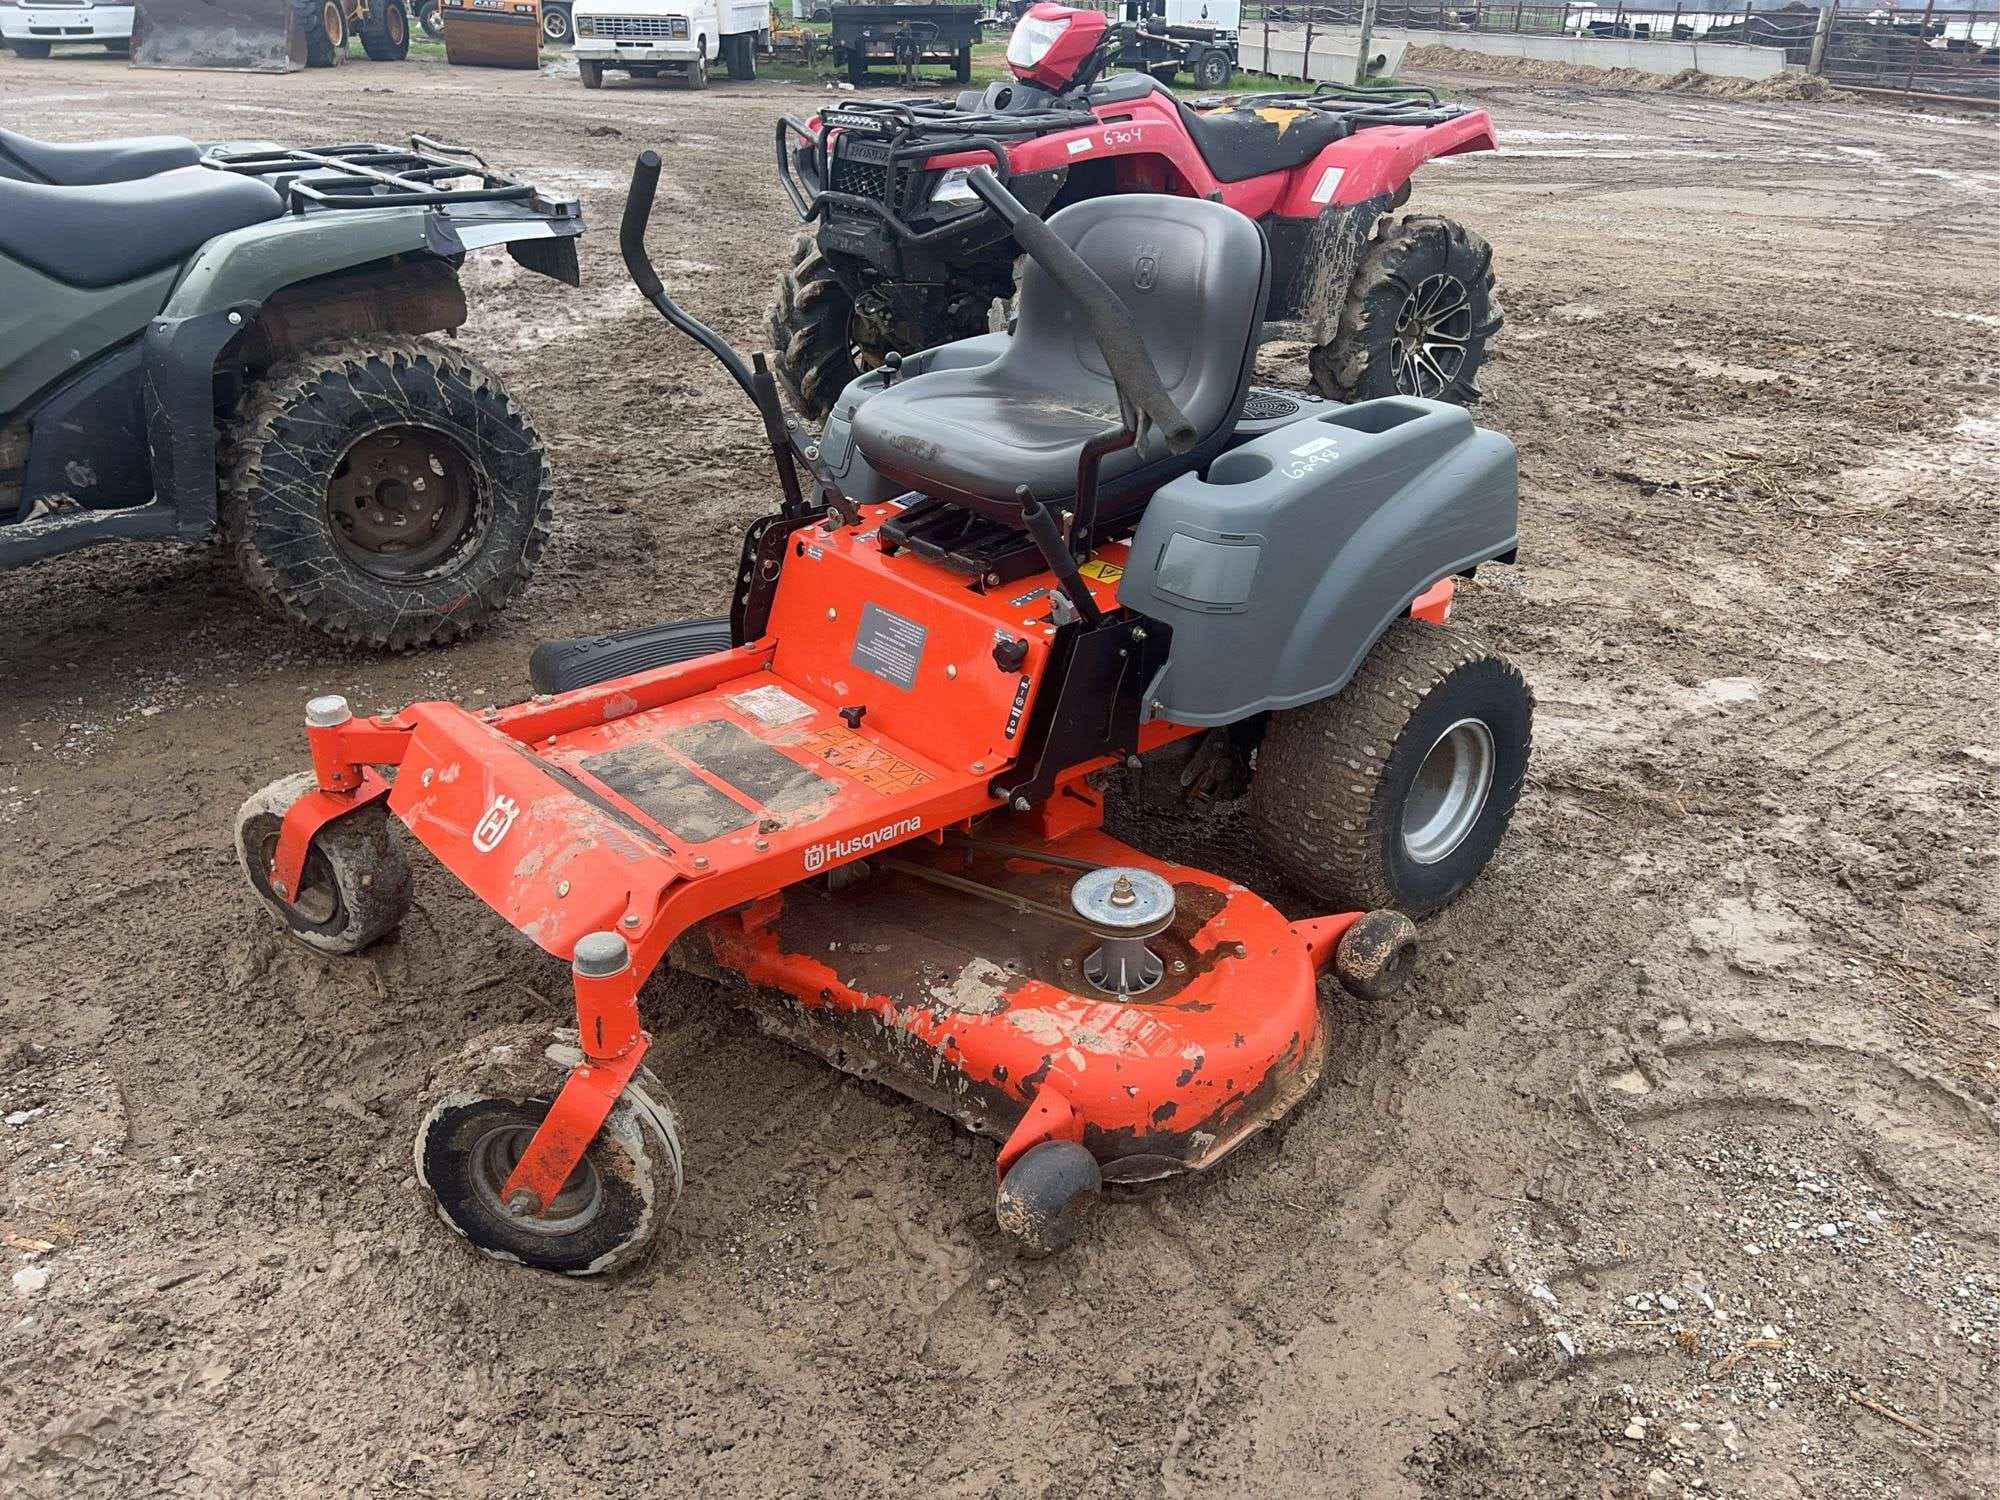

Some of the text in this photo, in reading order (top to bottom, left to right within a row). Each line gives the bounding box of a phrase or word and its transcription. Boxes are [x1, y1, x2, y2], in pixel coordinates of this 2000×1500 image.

[473, 0, 505, 10] CASE
[1103, 127, 1142, 146] 6304
[1281, 449, 1341, 480] 6298
[826, 815, 921, 862] Husqvarna
